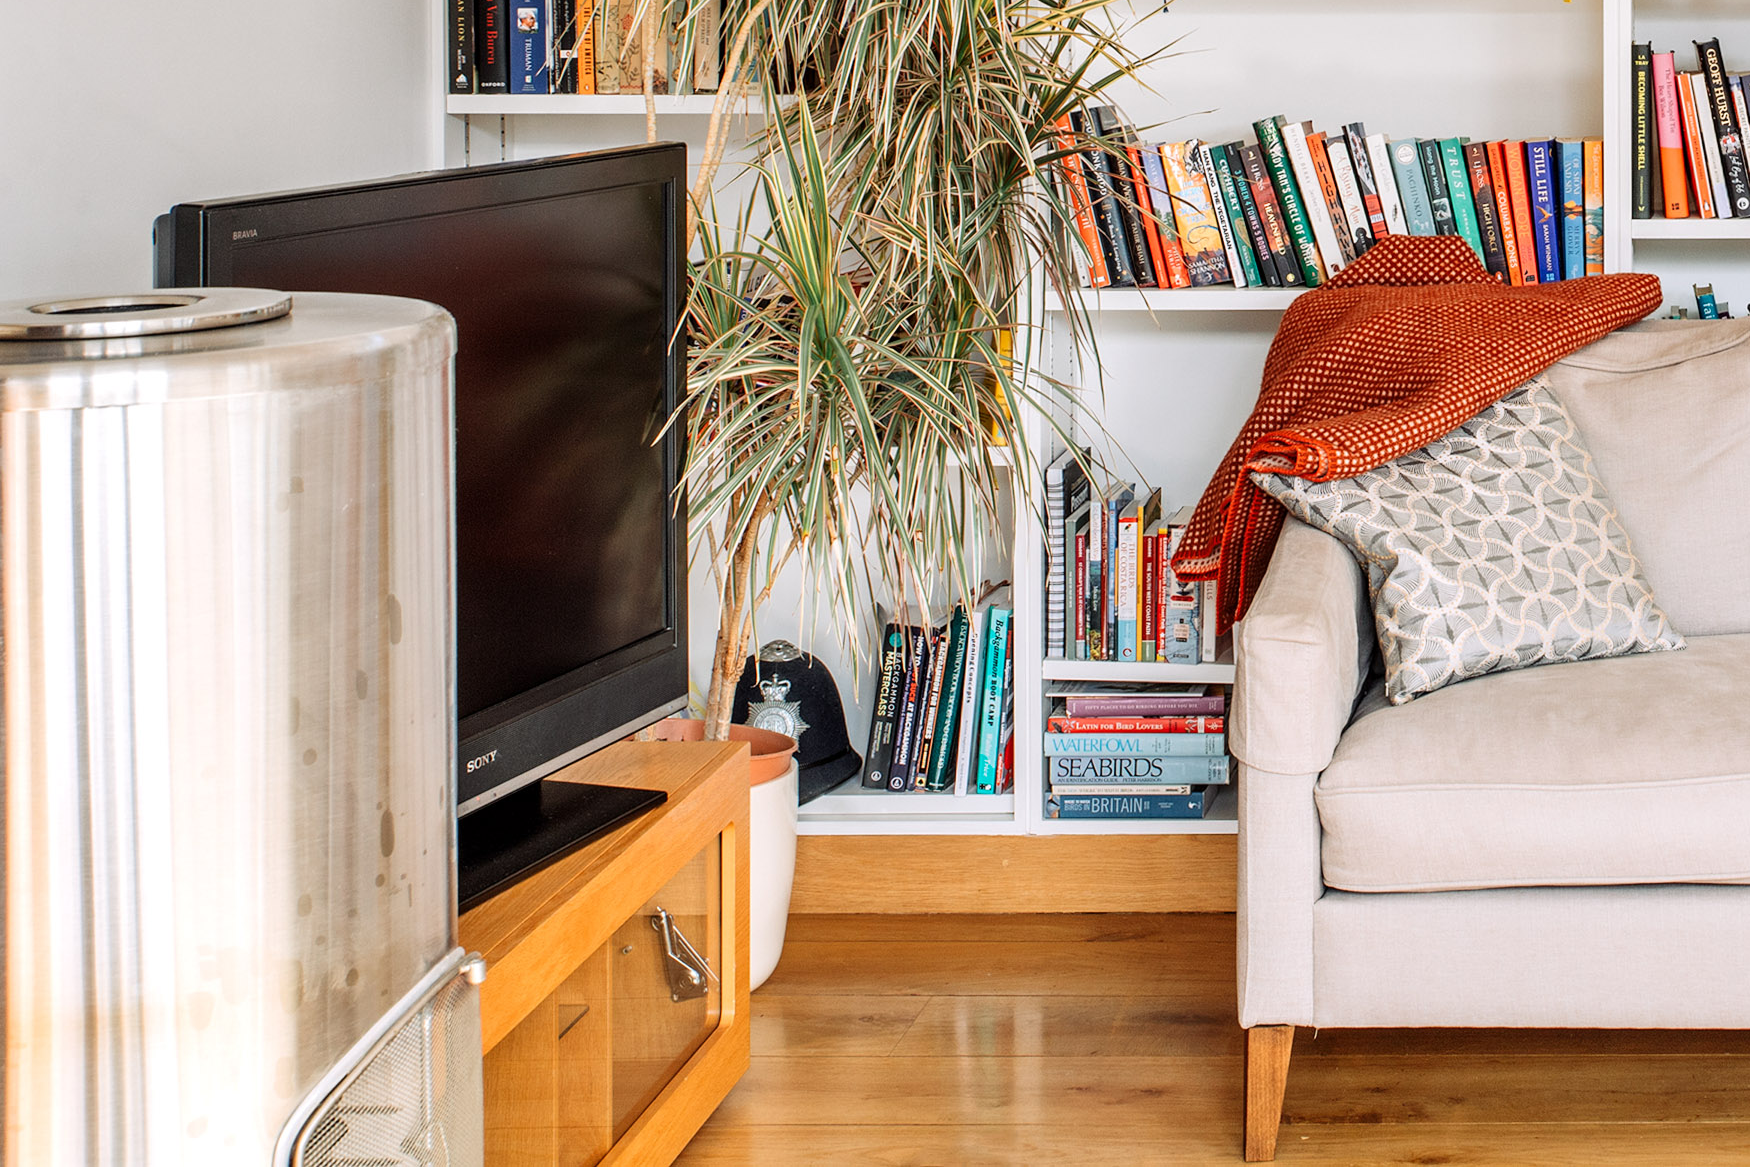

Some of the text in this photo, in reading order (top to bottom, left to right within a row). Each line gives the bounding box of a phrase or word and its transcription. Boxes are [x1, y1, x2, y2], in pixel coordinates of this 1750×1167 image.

[486, 5, 496, 27] Van
[486, 31, 497, 64] Buren
[1706, 48, 1733, 128] GEOFF HURST
[1406, 168, 1422, 217] PACHINKO
[1447, 146, 1466, 201] TRUST
[1534, 147, 1548, 203] STILL LIFE
[1203, 150, 1232, 250] HAN KANG THE VEGETARIAN
[1277, 168, 1315, 267] TAN'S CIRCLE OF WOMEN
[232, 228, 258, 241] BRAVIA
[1264, 202, 1285, 256] HEAVENFIELD
[1483, 203, 1498, 253] HIGH FORCE
[1498, 191, 1519, 268] COLUMBA'S BONES
[1121, 543, 1127, 553] OF
[877, 651, 893, 717] MASTERCLASS
[987, 619, 1005, 726] Backgammon BOOT CAMP
[1052, 739, 1142, 752] WATERFOWL
[1076, 722, 1098, 730] LATIN
[466, 749, 498, 774] SONY
[1058, 758, 1163, 777] SEABIRDS
[1092, 799, 1142, 812] BRITAIN
